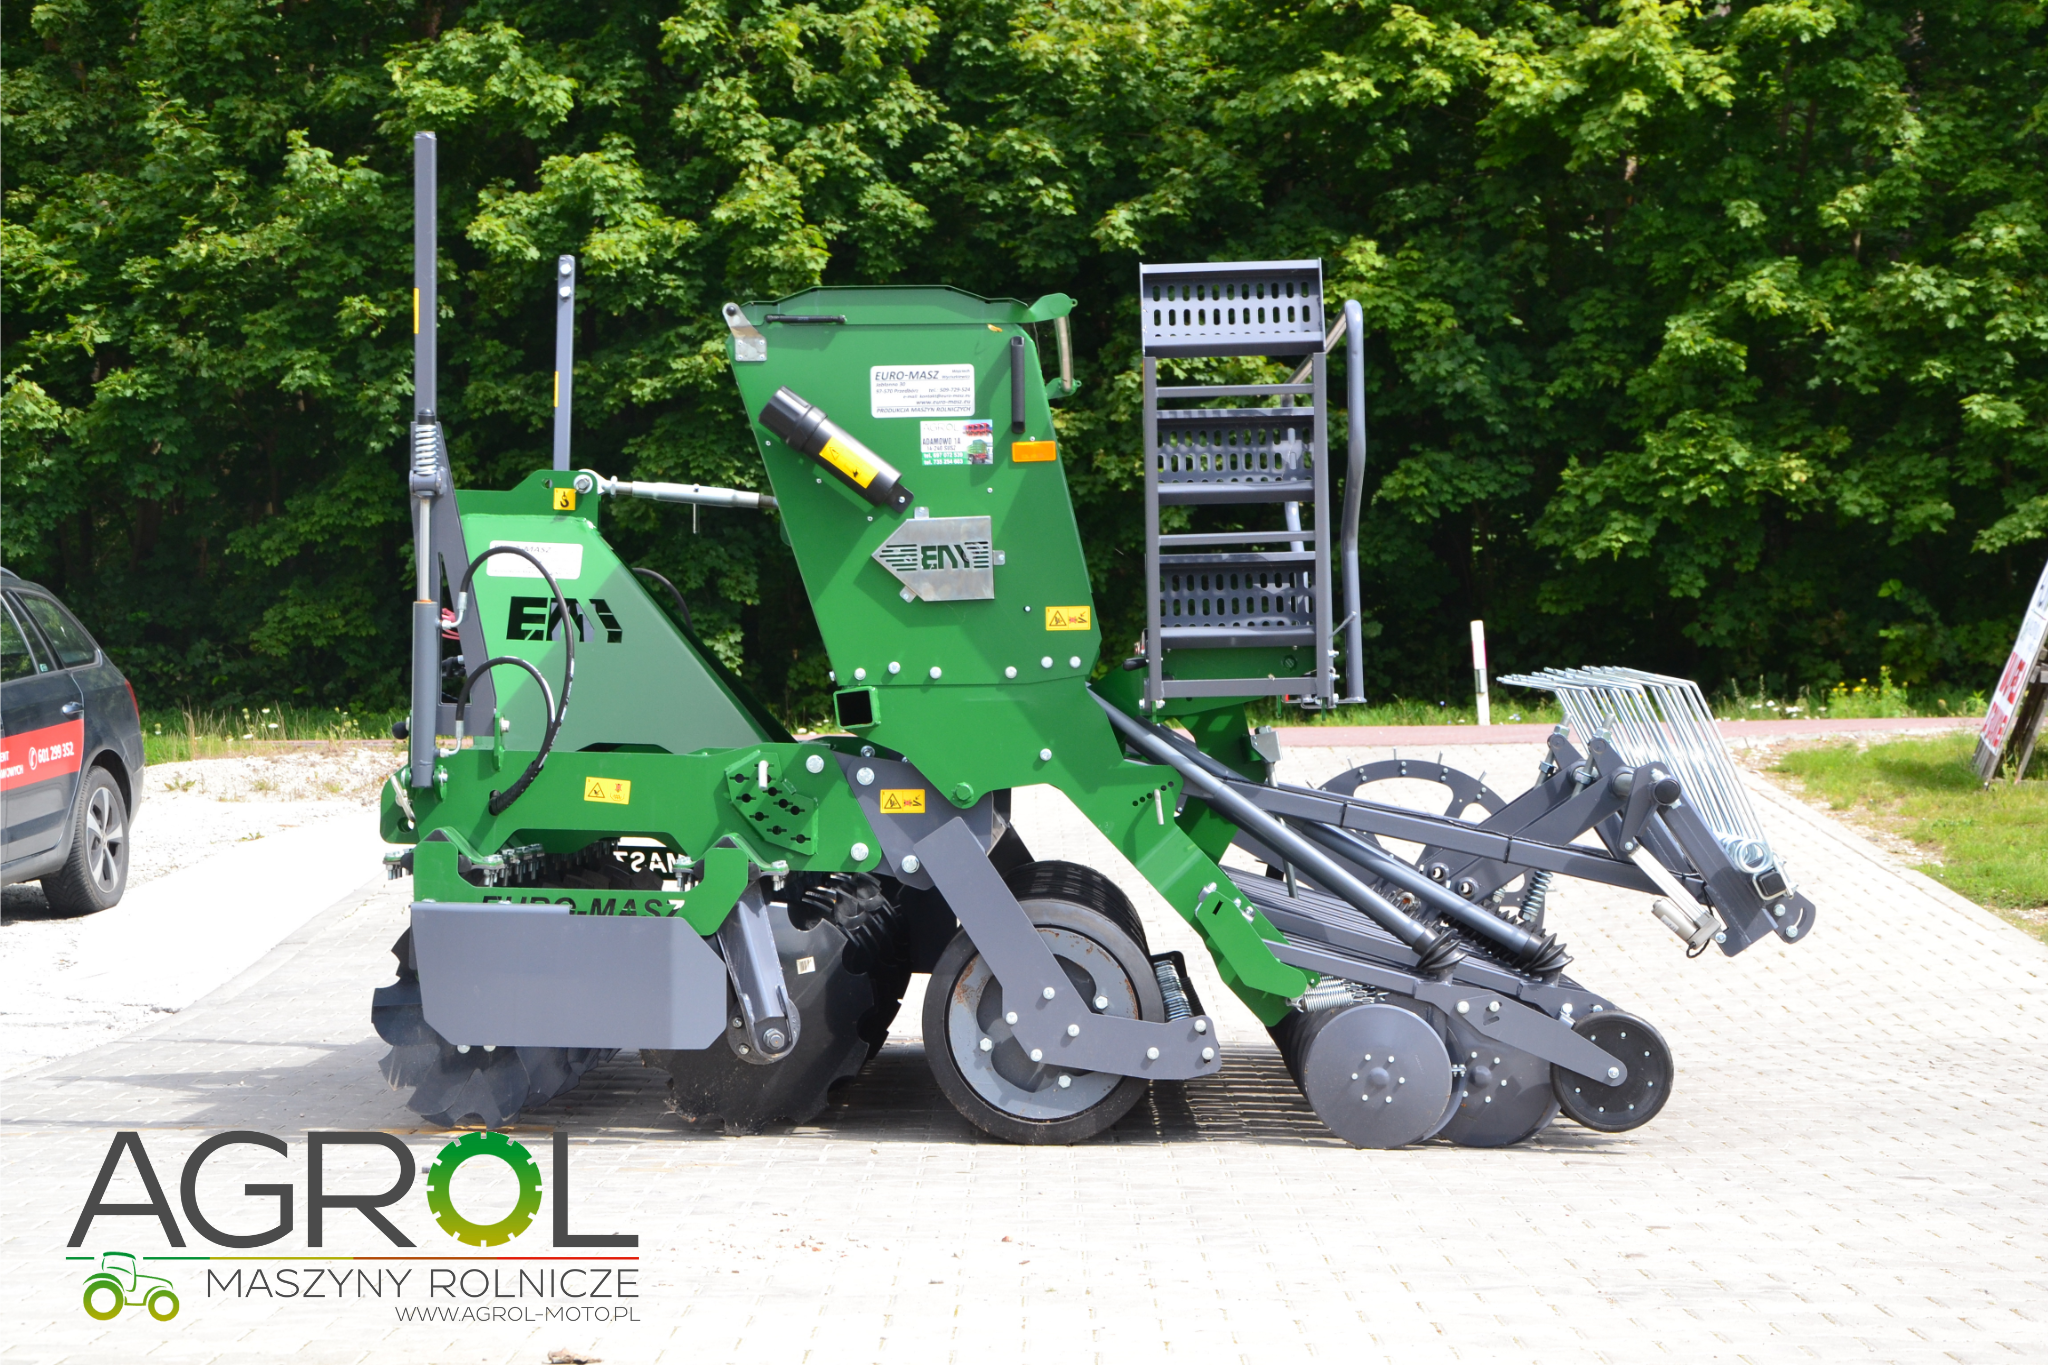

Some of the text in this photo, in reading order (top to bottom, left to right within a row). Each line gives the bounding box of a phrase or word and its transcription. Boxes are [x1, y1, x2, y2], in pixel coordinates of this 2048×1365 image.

[875, 370, 939, 380] EURO-MASZ
[38, 742, 74, 763] 601 299 352
